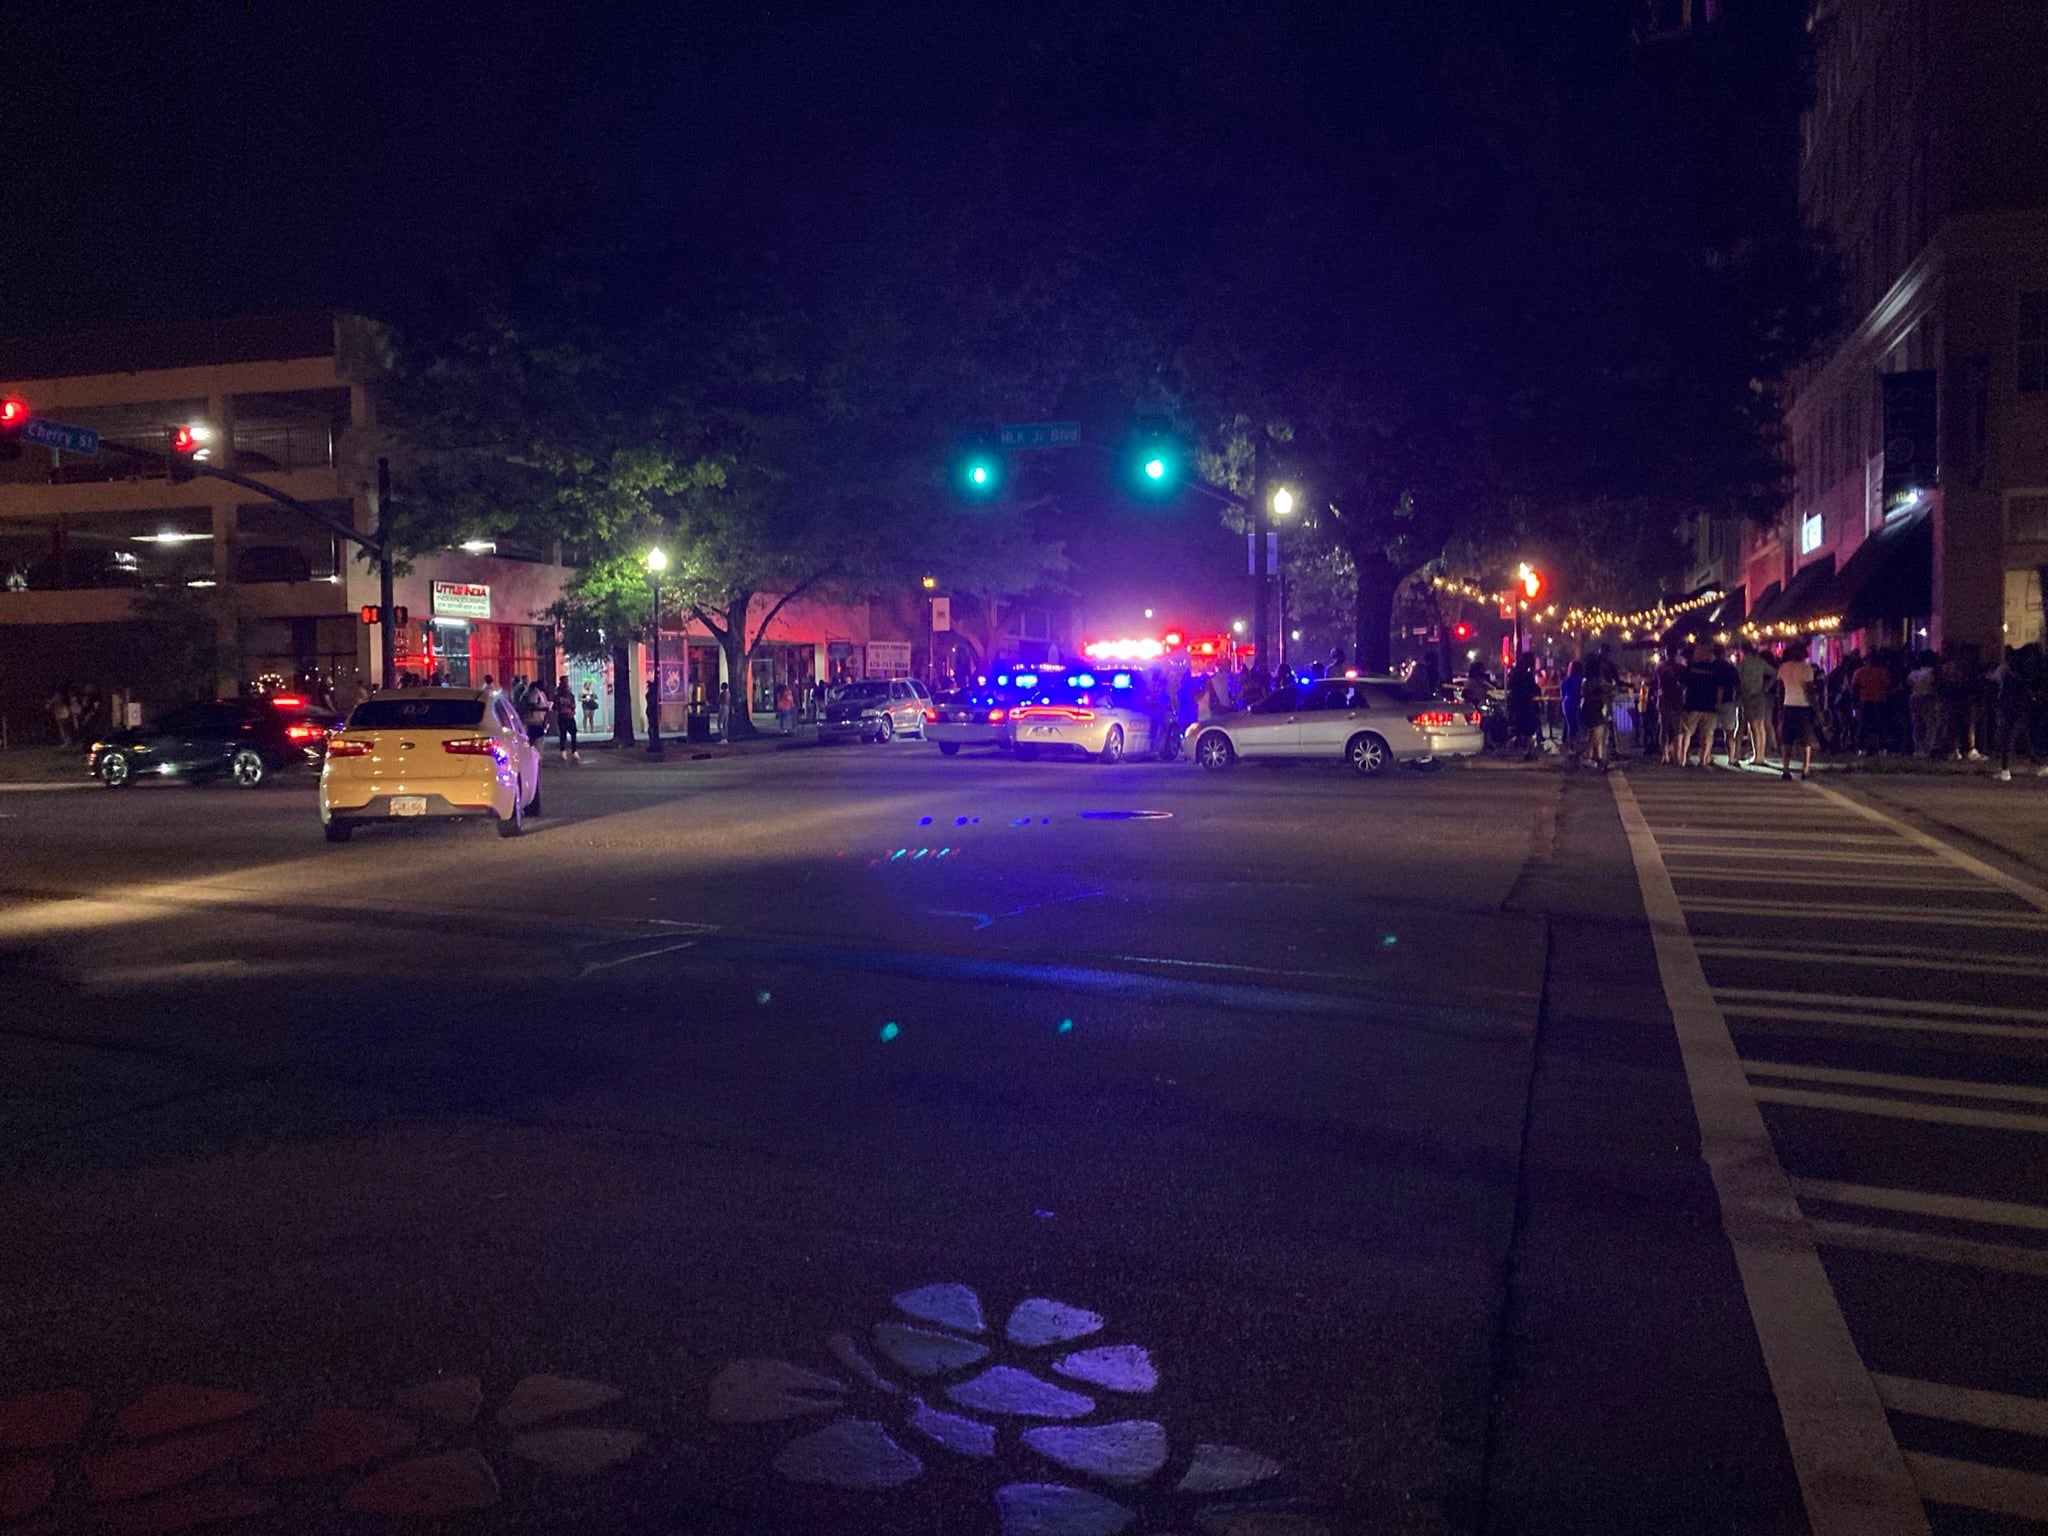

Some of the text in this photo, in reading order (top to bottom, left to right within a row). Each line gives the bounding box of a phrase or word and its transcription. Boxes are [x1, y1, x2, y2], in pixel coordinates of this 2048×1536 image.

[28, 424, 95, 449] Cherry St
[1000, 427, 1078, 445] MLK Jr Blvd
[436, 582, 486, 597] LITTLE INDIA
